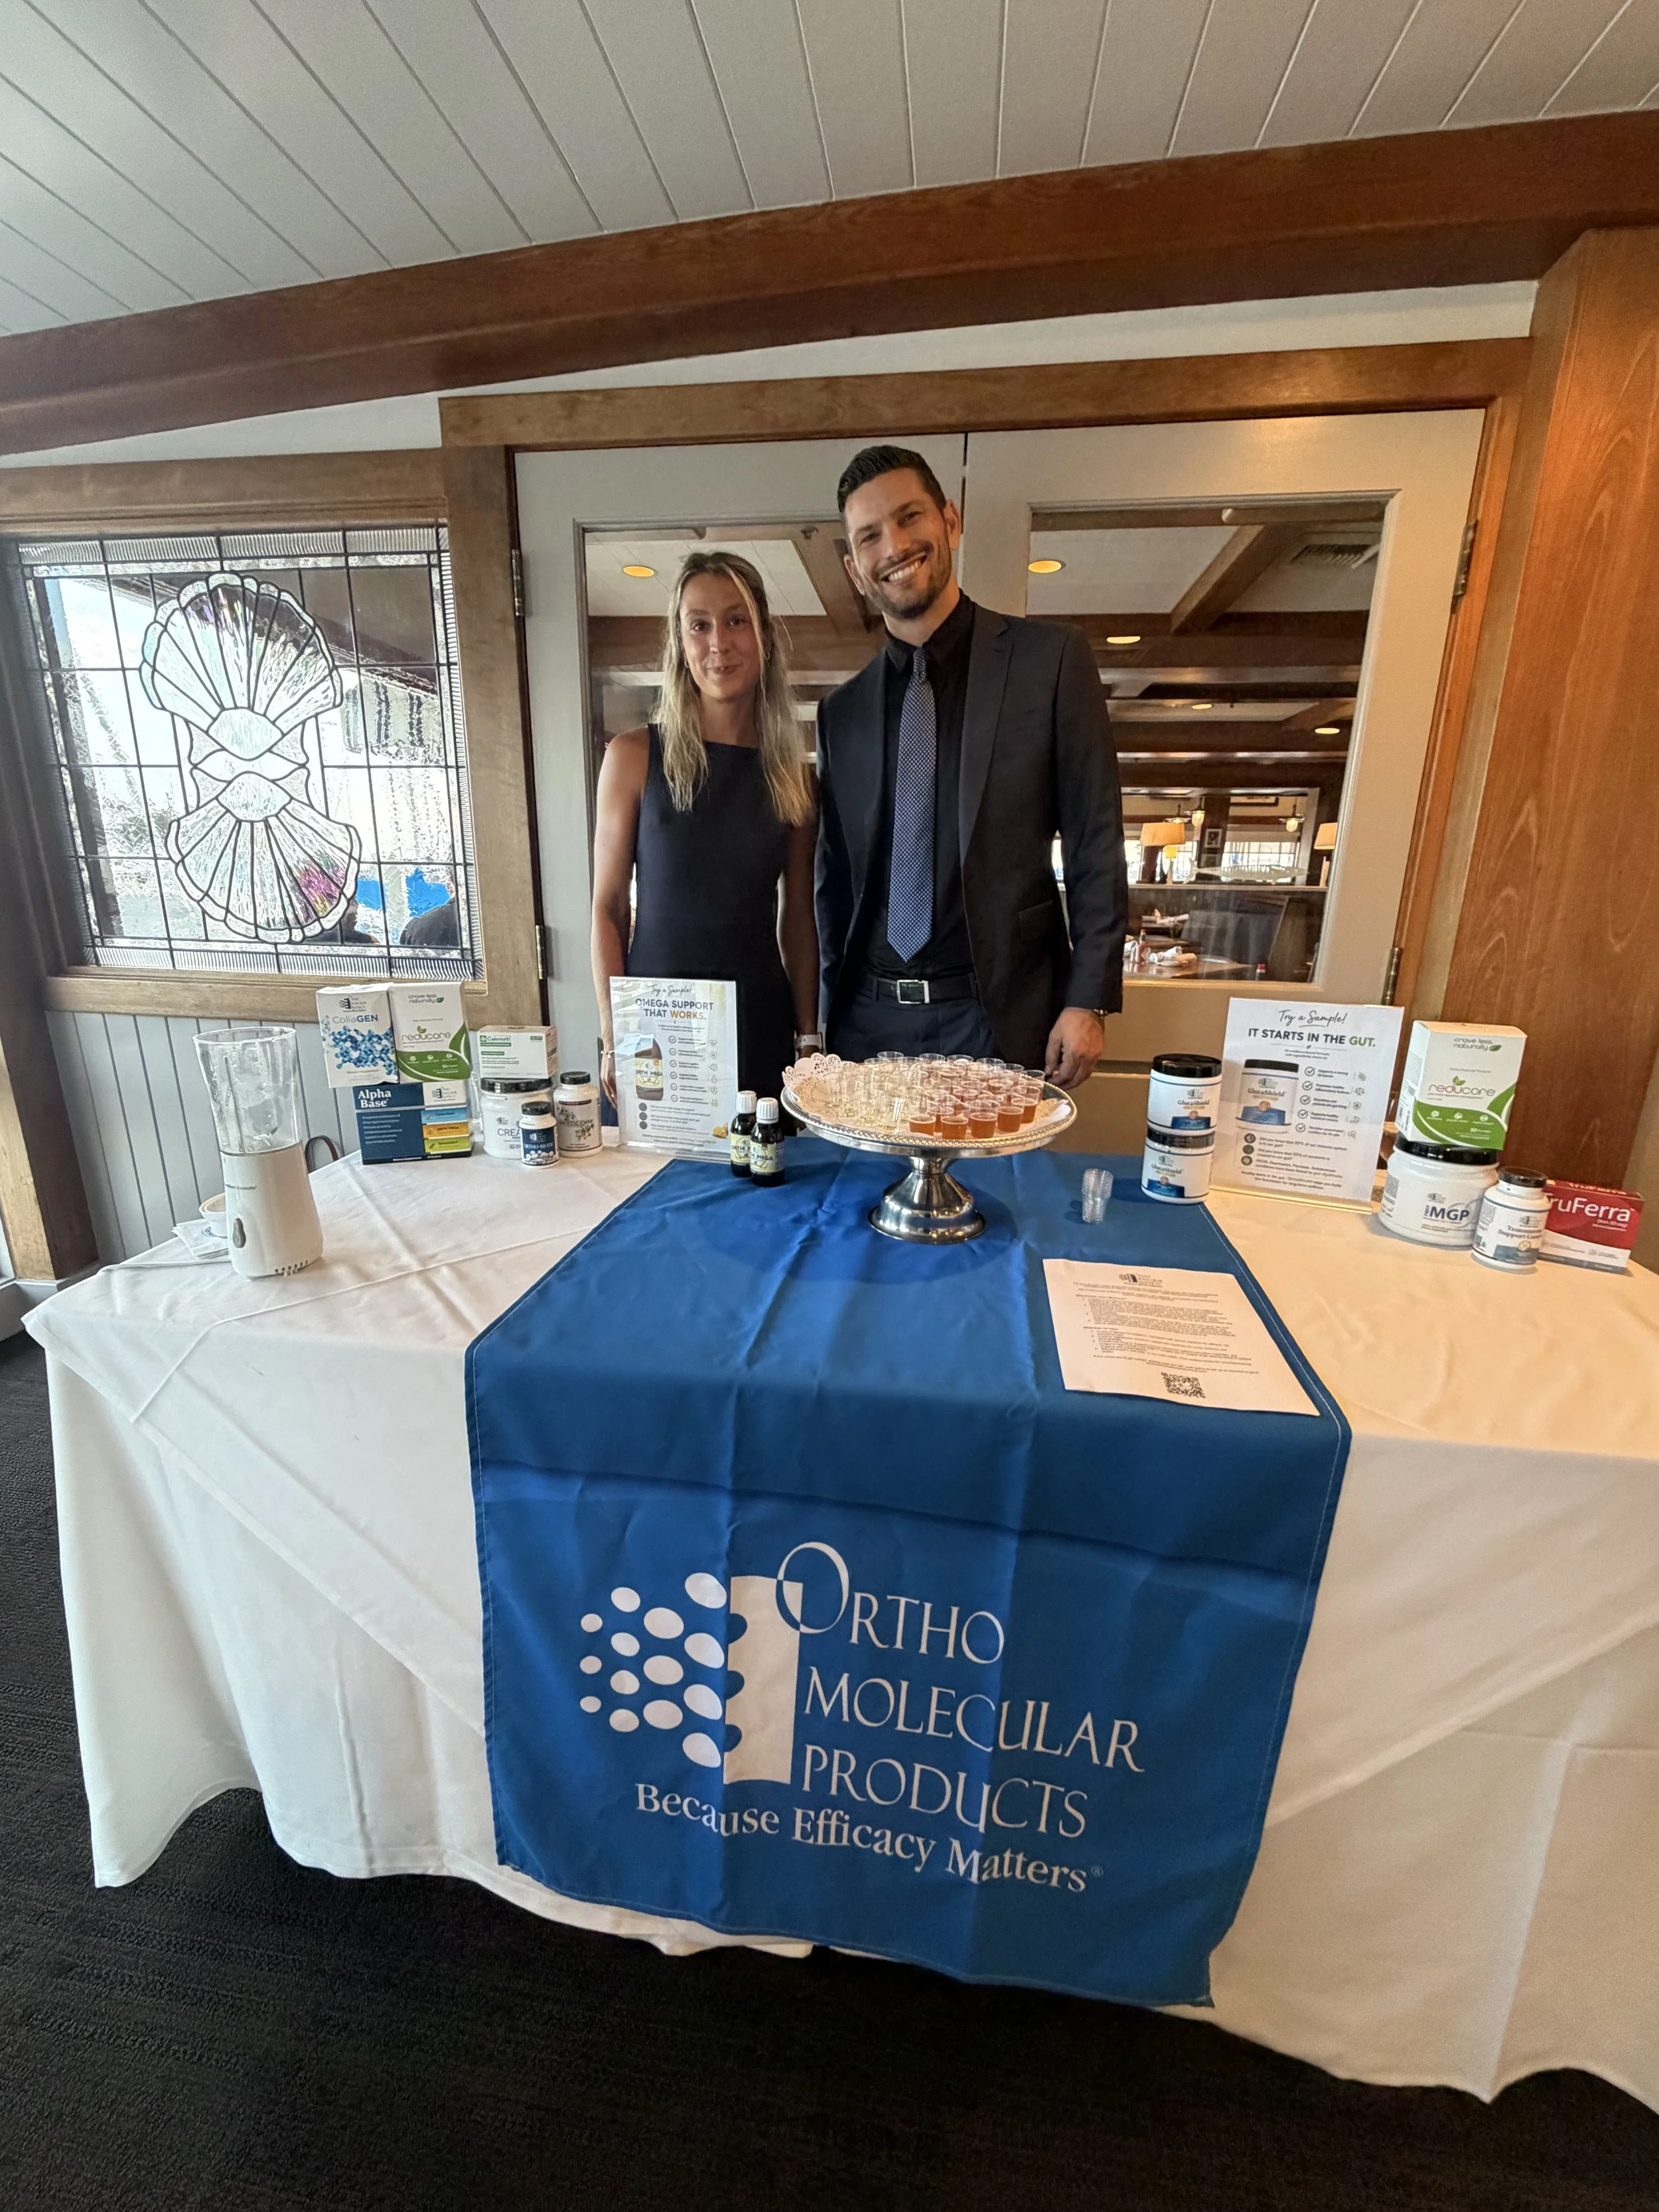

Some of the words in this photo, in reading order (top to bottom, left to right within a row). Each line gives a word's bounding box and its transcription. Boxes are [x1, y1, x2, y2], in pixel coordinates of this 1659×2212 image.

[649, 984, 661, 996] Try
[667, 984, 693, 995] Sample!
[635, 997, 670, 1008] OMEGA
[672, 999, 714, 1011] SUPPORT
[332, 1014, 379, 1025] CollaGEN
[643, 1008, 668, 1018] THAT
[670, 1010, 707, 1021] WORKS.
[1278, 1009, 1296, 1027] Try
[1307, 1009, 1348, 1027] Sample!
[401, 1031, 451, 1041] reducore
[1248, 1027, 1260, 1038] IT
[1261, 1029, 1304, 1042] STARTS
[1307, 1032, 1320, 1043] IN
[1323, 1033, 1346, 1045] THE
[1348, 1035, 1376, 1047] GUT.
[1453, 1043, 1488, 1052] naturally
[357, 1088, 392, 1101] Alpha
[1247, 1088, 1285, 1098] GlutaShield
[1428, 1082, 1496, 1097] reducore
[360, 1098, 389, 1109] Base
[775, 1541, 1005, 1664] ORTHO
[803, 1666, 1145, 1773] MOLECULAR
[802, 1743, 1088, 1838] PRODUCTS
[634, 1782, 780, 1836] Because
[792, 1806, 936, 1873] Efficacy
